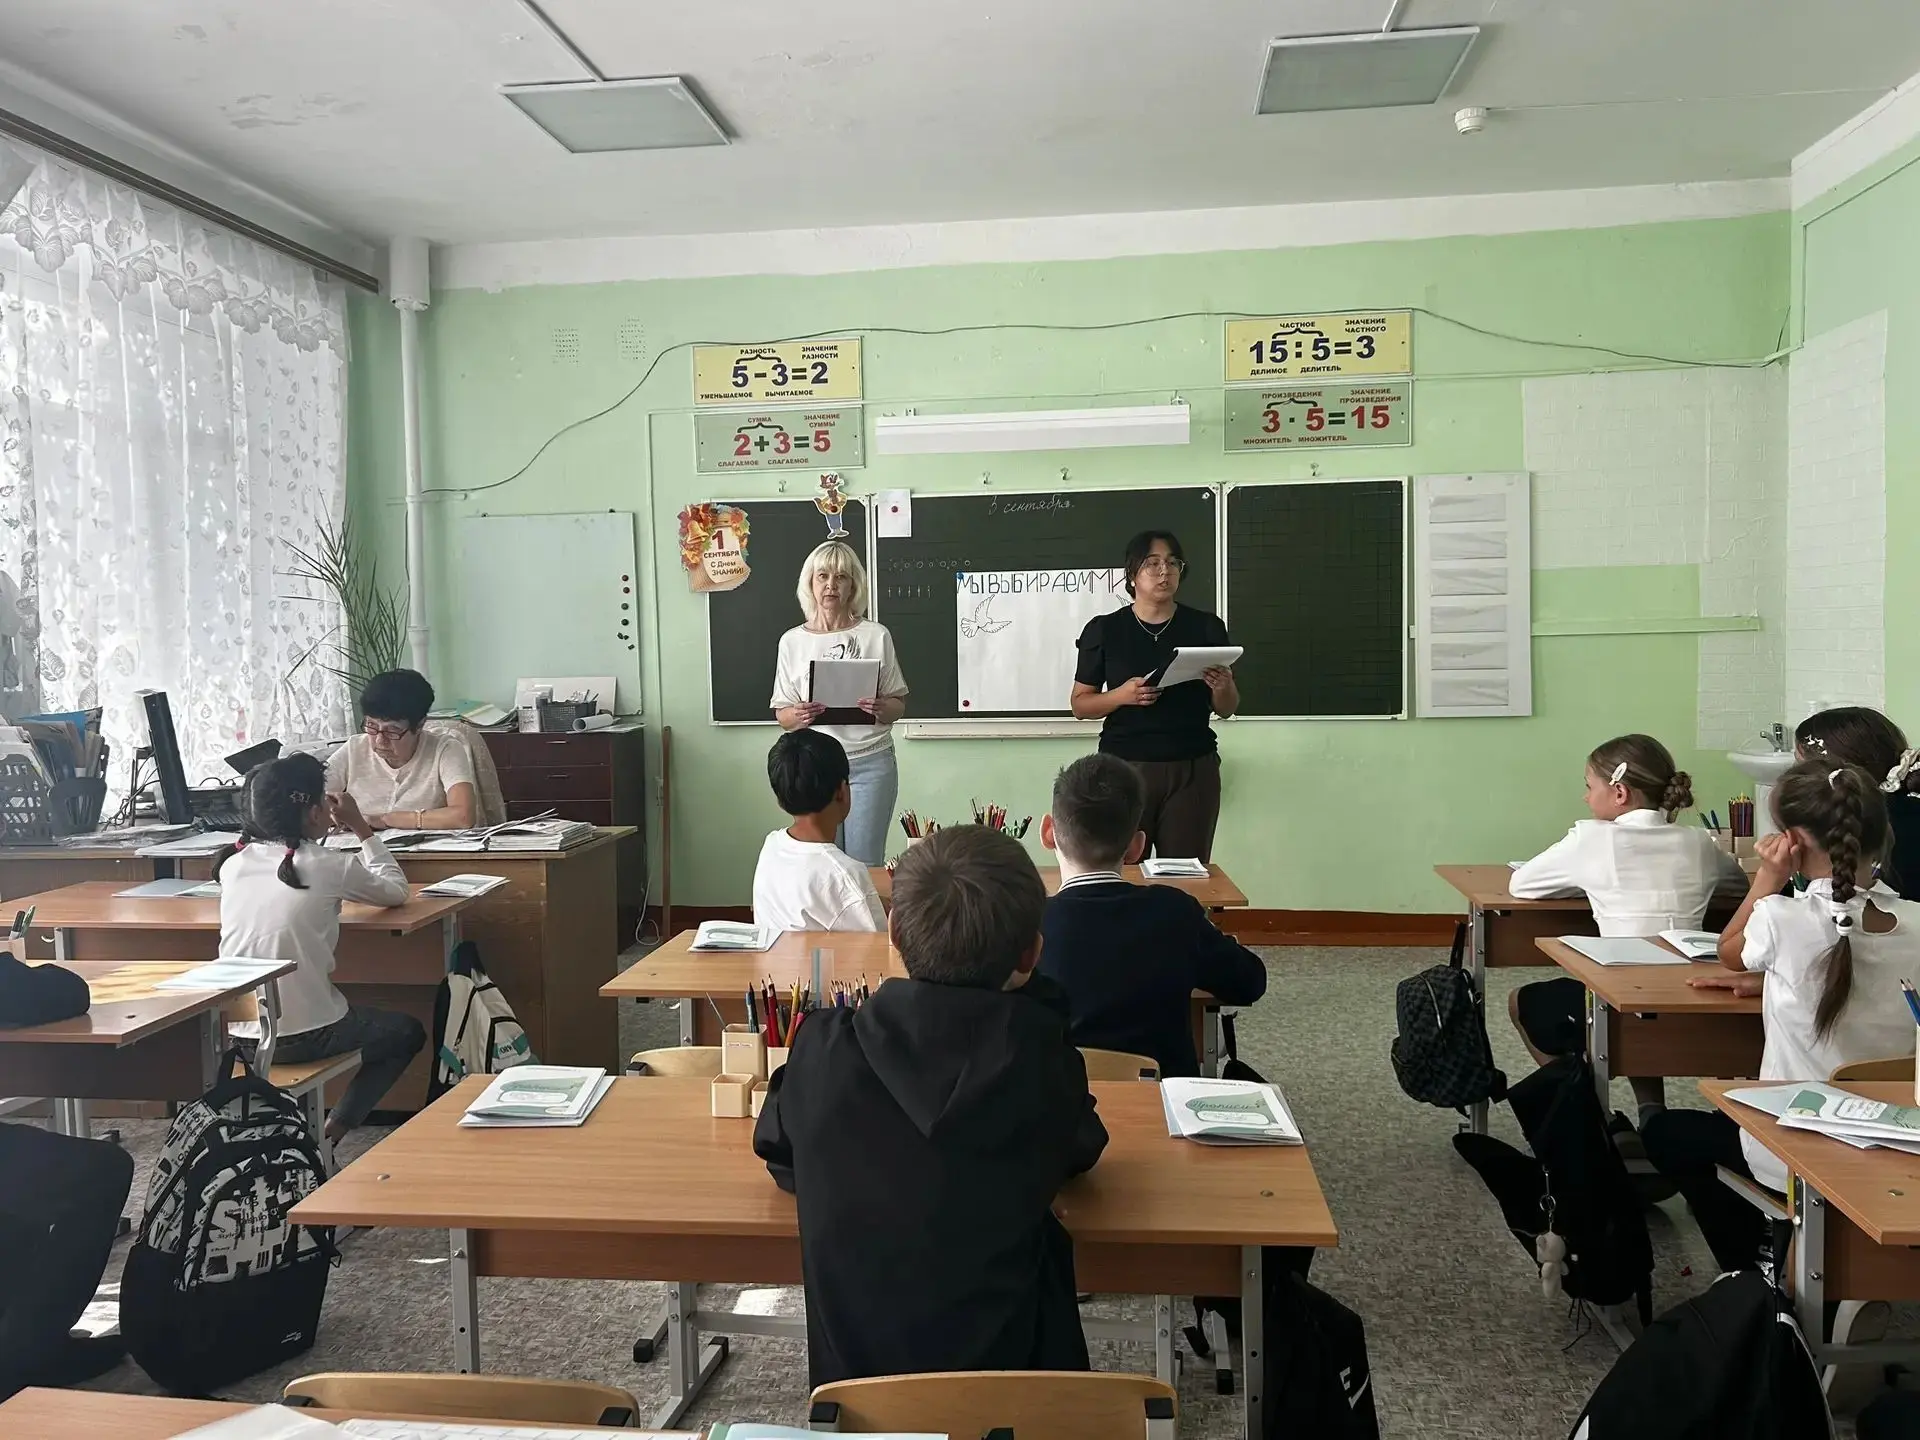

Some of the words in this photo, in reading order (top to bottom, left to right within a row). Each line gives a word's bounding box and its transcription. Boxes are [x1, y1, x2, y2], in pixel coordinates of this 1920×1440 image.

[1279, 321, 1316, 329] ЧАСТНОЕ
[1344, 317, 1386, 326] ЗНАЧЕНИЕ
[1344, 325, 1387, 333] ЧАСТНОГО
[740, 347, 776, 355] РАЗНОСТЬ
[801, 344, 838, 352] ЗНАЧЕНИЕ
[1250, 367, 1288, 376] ДЕЛИМОЕ
[1299, 365, 1342, 374] ДЕЛИТЕЛЬ
[700, 391, 753, 400] УМЕНЬШАЕМОЕ
[765, 389, 814, 398] ВЫЧИТАЕМОЕ
[1261, 390, 1323, 399] ПРОИЗВЕДЕНИЕ
[1350, 387, 1392, 396] ЗНАЧЕНИЕ
[1339, 395, 1402, 404] ПРОИЗВЕДЕНИЯ
[803, 413, 841, 421] ЗНАЧЕНИЕ
[1243, 436, 1292, 445] МНОЖИТЕЛЬ
[1298, 435, 1348, 443] МНОЖИТЕЛЬ
[717, 459, 759, 468] СЛАГАЕМОЕ
[767, 457, 809, 466] СЛАГАЕМОЕ
[711, 529, 724, 550] 1
[703, 550, 741, 559] СЕНТЯБРЯ
[957, 574, 985, 594] МЫ
[1091, 568, 1127, 594] МИ
